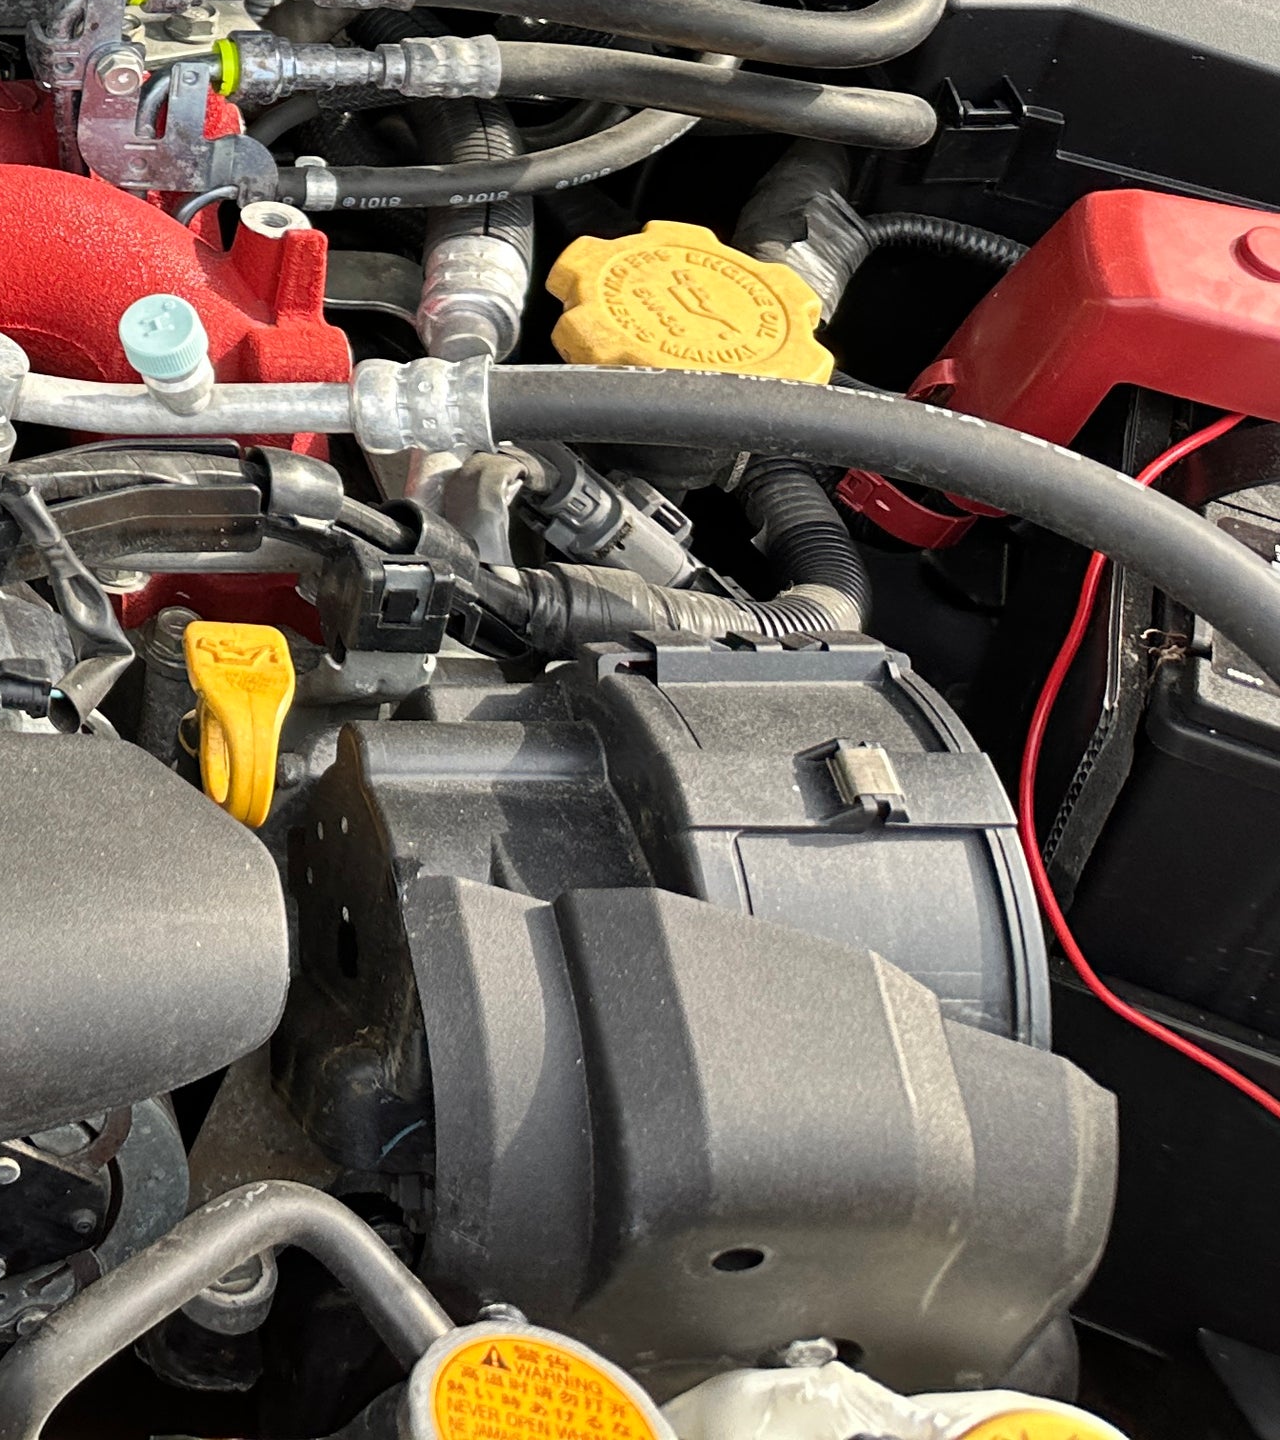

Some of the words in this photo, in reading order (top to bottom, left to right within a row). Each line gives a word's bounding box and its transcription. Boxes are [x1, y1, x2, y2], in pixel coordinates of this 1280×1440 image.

[685, 252, 774, 309] ENGINE
[756, 310, 781, 341] OIL
[659, 339, 760, 365] MANUAL
[513, 1361, 603, 1396] WARNING
[447, 1396, 500, 1423] NEVER
[505, 1411, 551, 1437] OPEN
